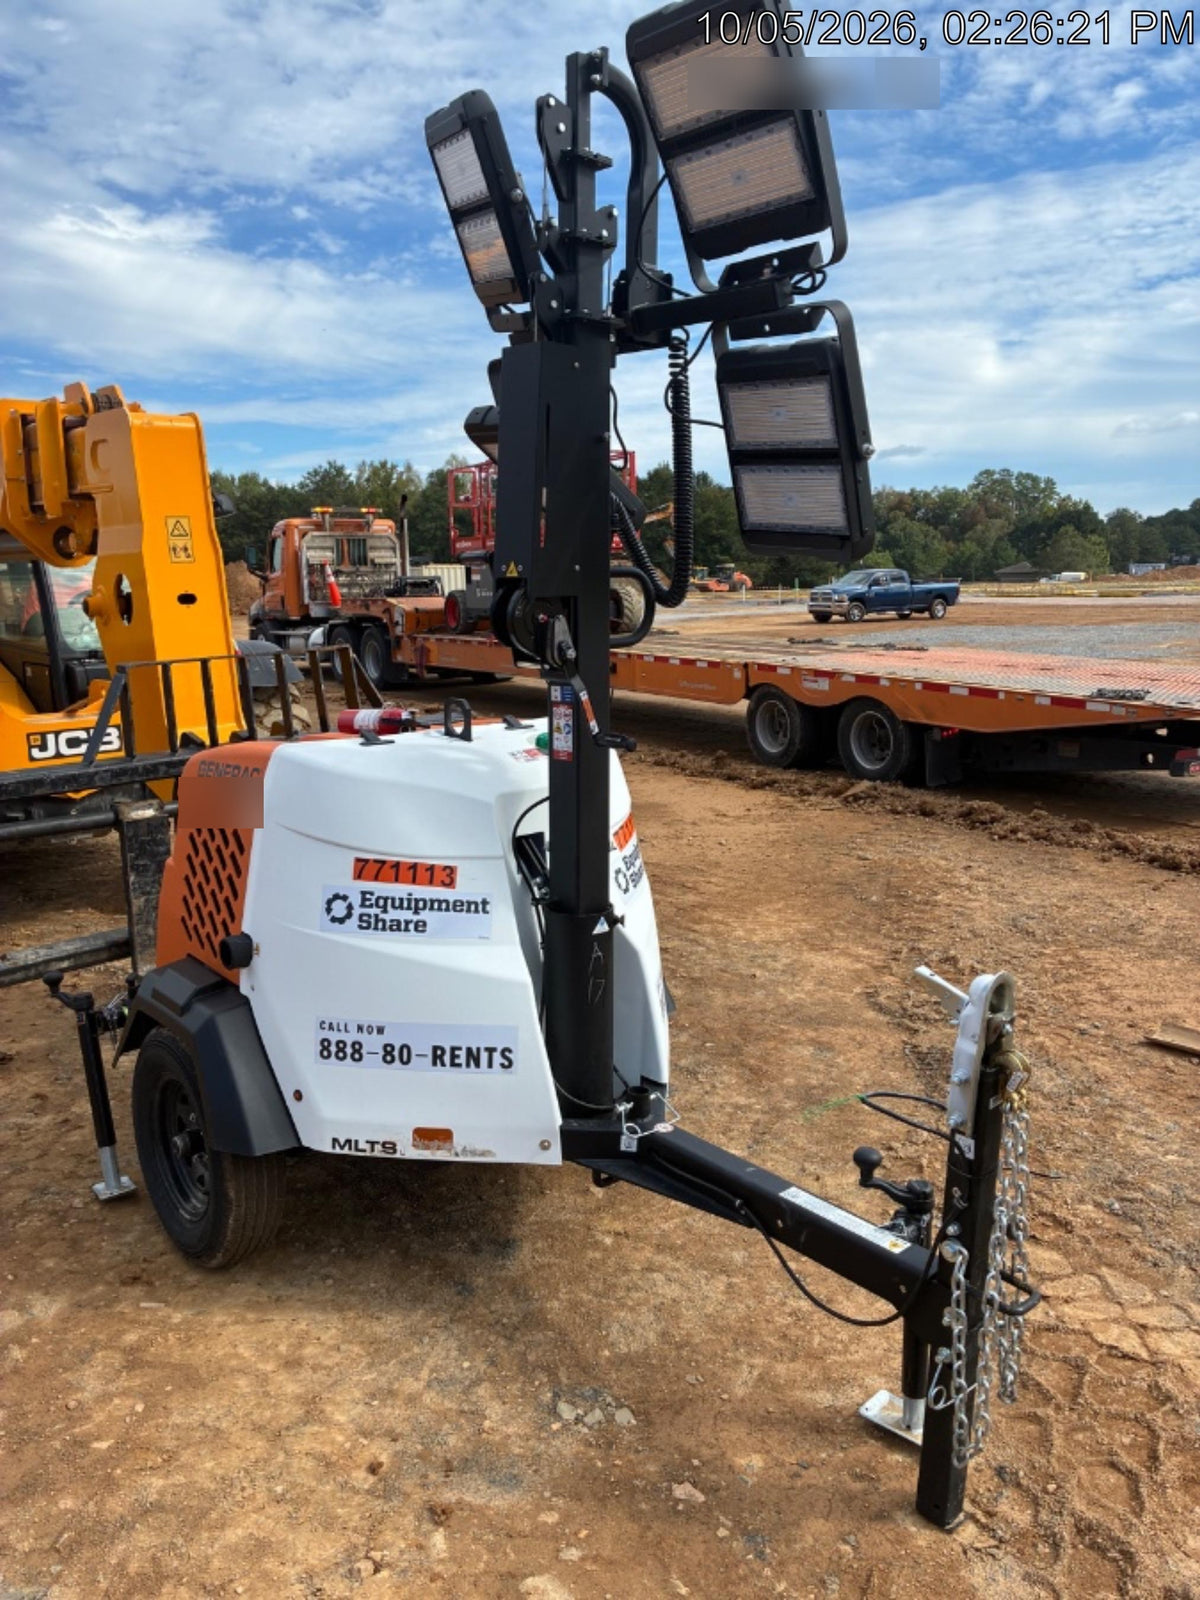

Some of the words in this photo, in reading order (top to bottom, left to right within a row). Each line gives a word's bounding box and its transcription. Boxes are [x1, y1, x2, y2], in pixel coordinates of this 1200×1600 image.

[30, 726, 121, 759] JCB
[354, 859, 457, 888] 771113
[359, 890, 490, 915] Equipment
[357, 913, 427, 934] Share
[319, 1020, 351, 1034] CALL
[356, 1023, 386, 1036] NOW
[319, 1037, 514, 1070] 888-80-RENTS
[331, 1137, 397, 1156] MLTS
